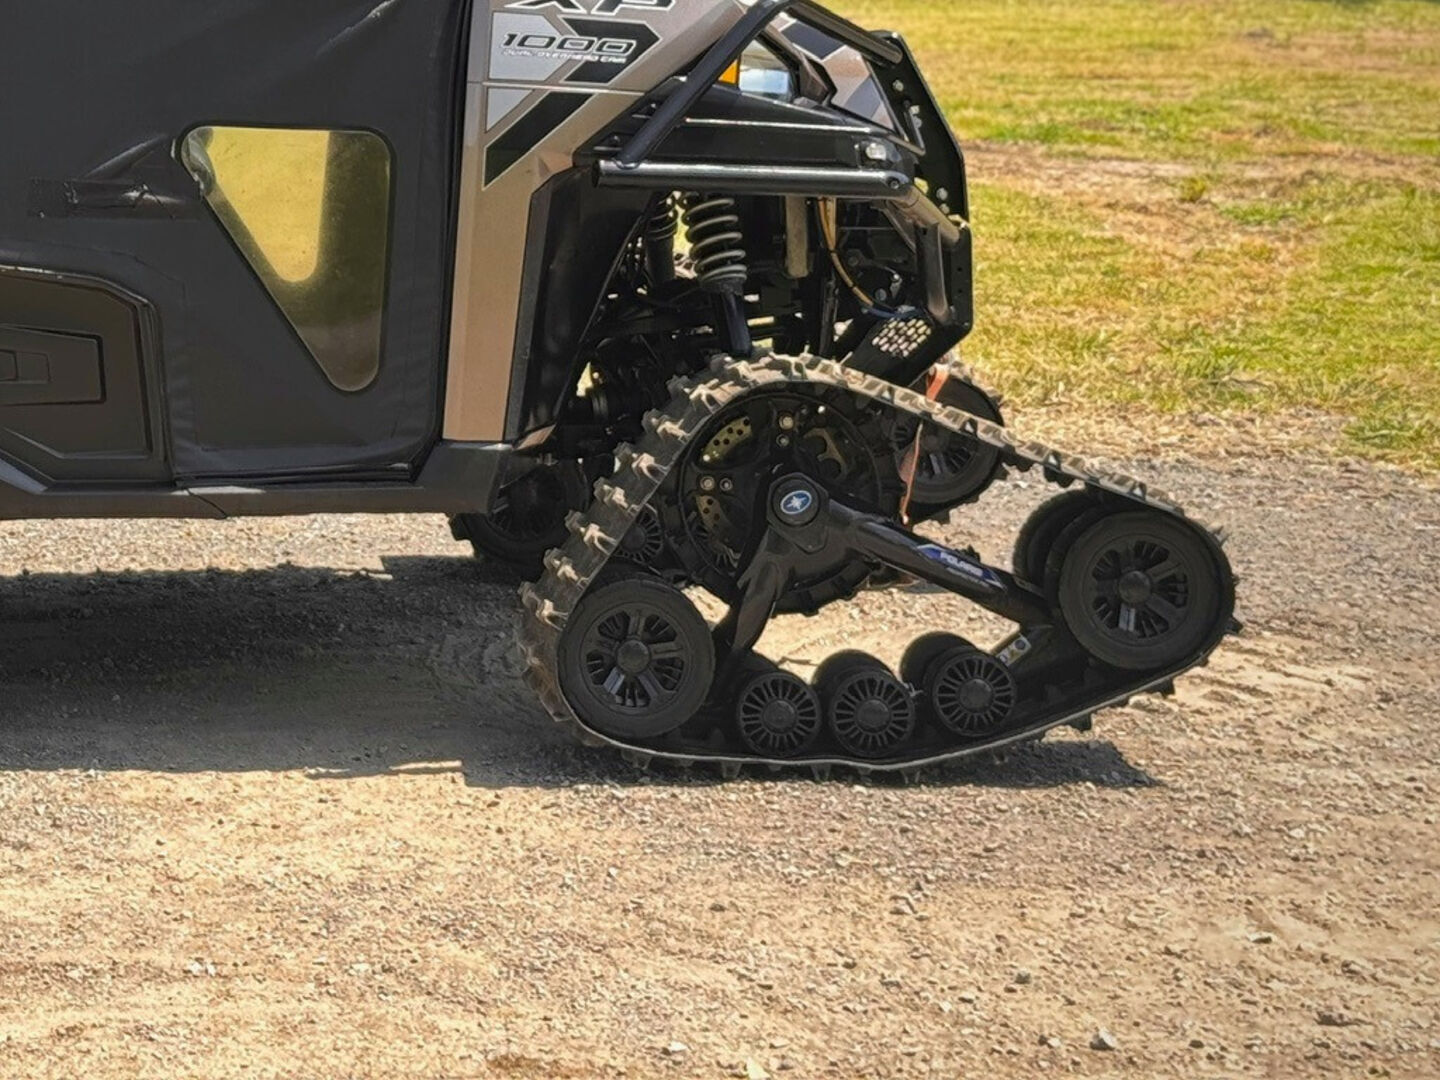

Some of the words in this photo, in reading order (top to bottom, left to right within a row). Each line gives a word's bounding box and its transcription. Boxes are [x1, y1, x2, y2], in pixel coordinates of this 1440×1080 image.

[502, 32, 636, 56] 1000
[537, 51, 599, 62] OVERHEAD
[600, 55, 626, 64] CAM
[940, 551, 983, 577] POLARIS
